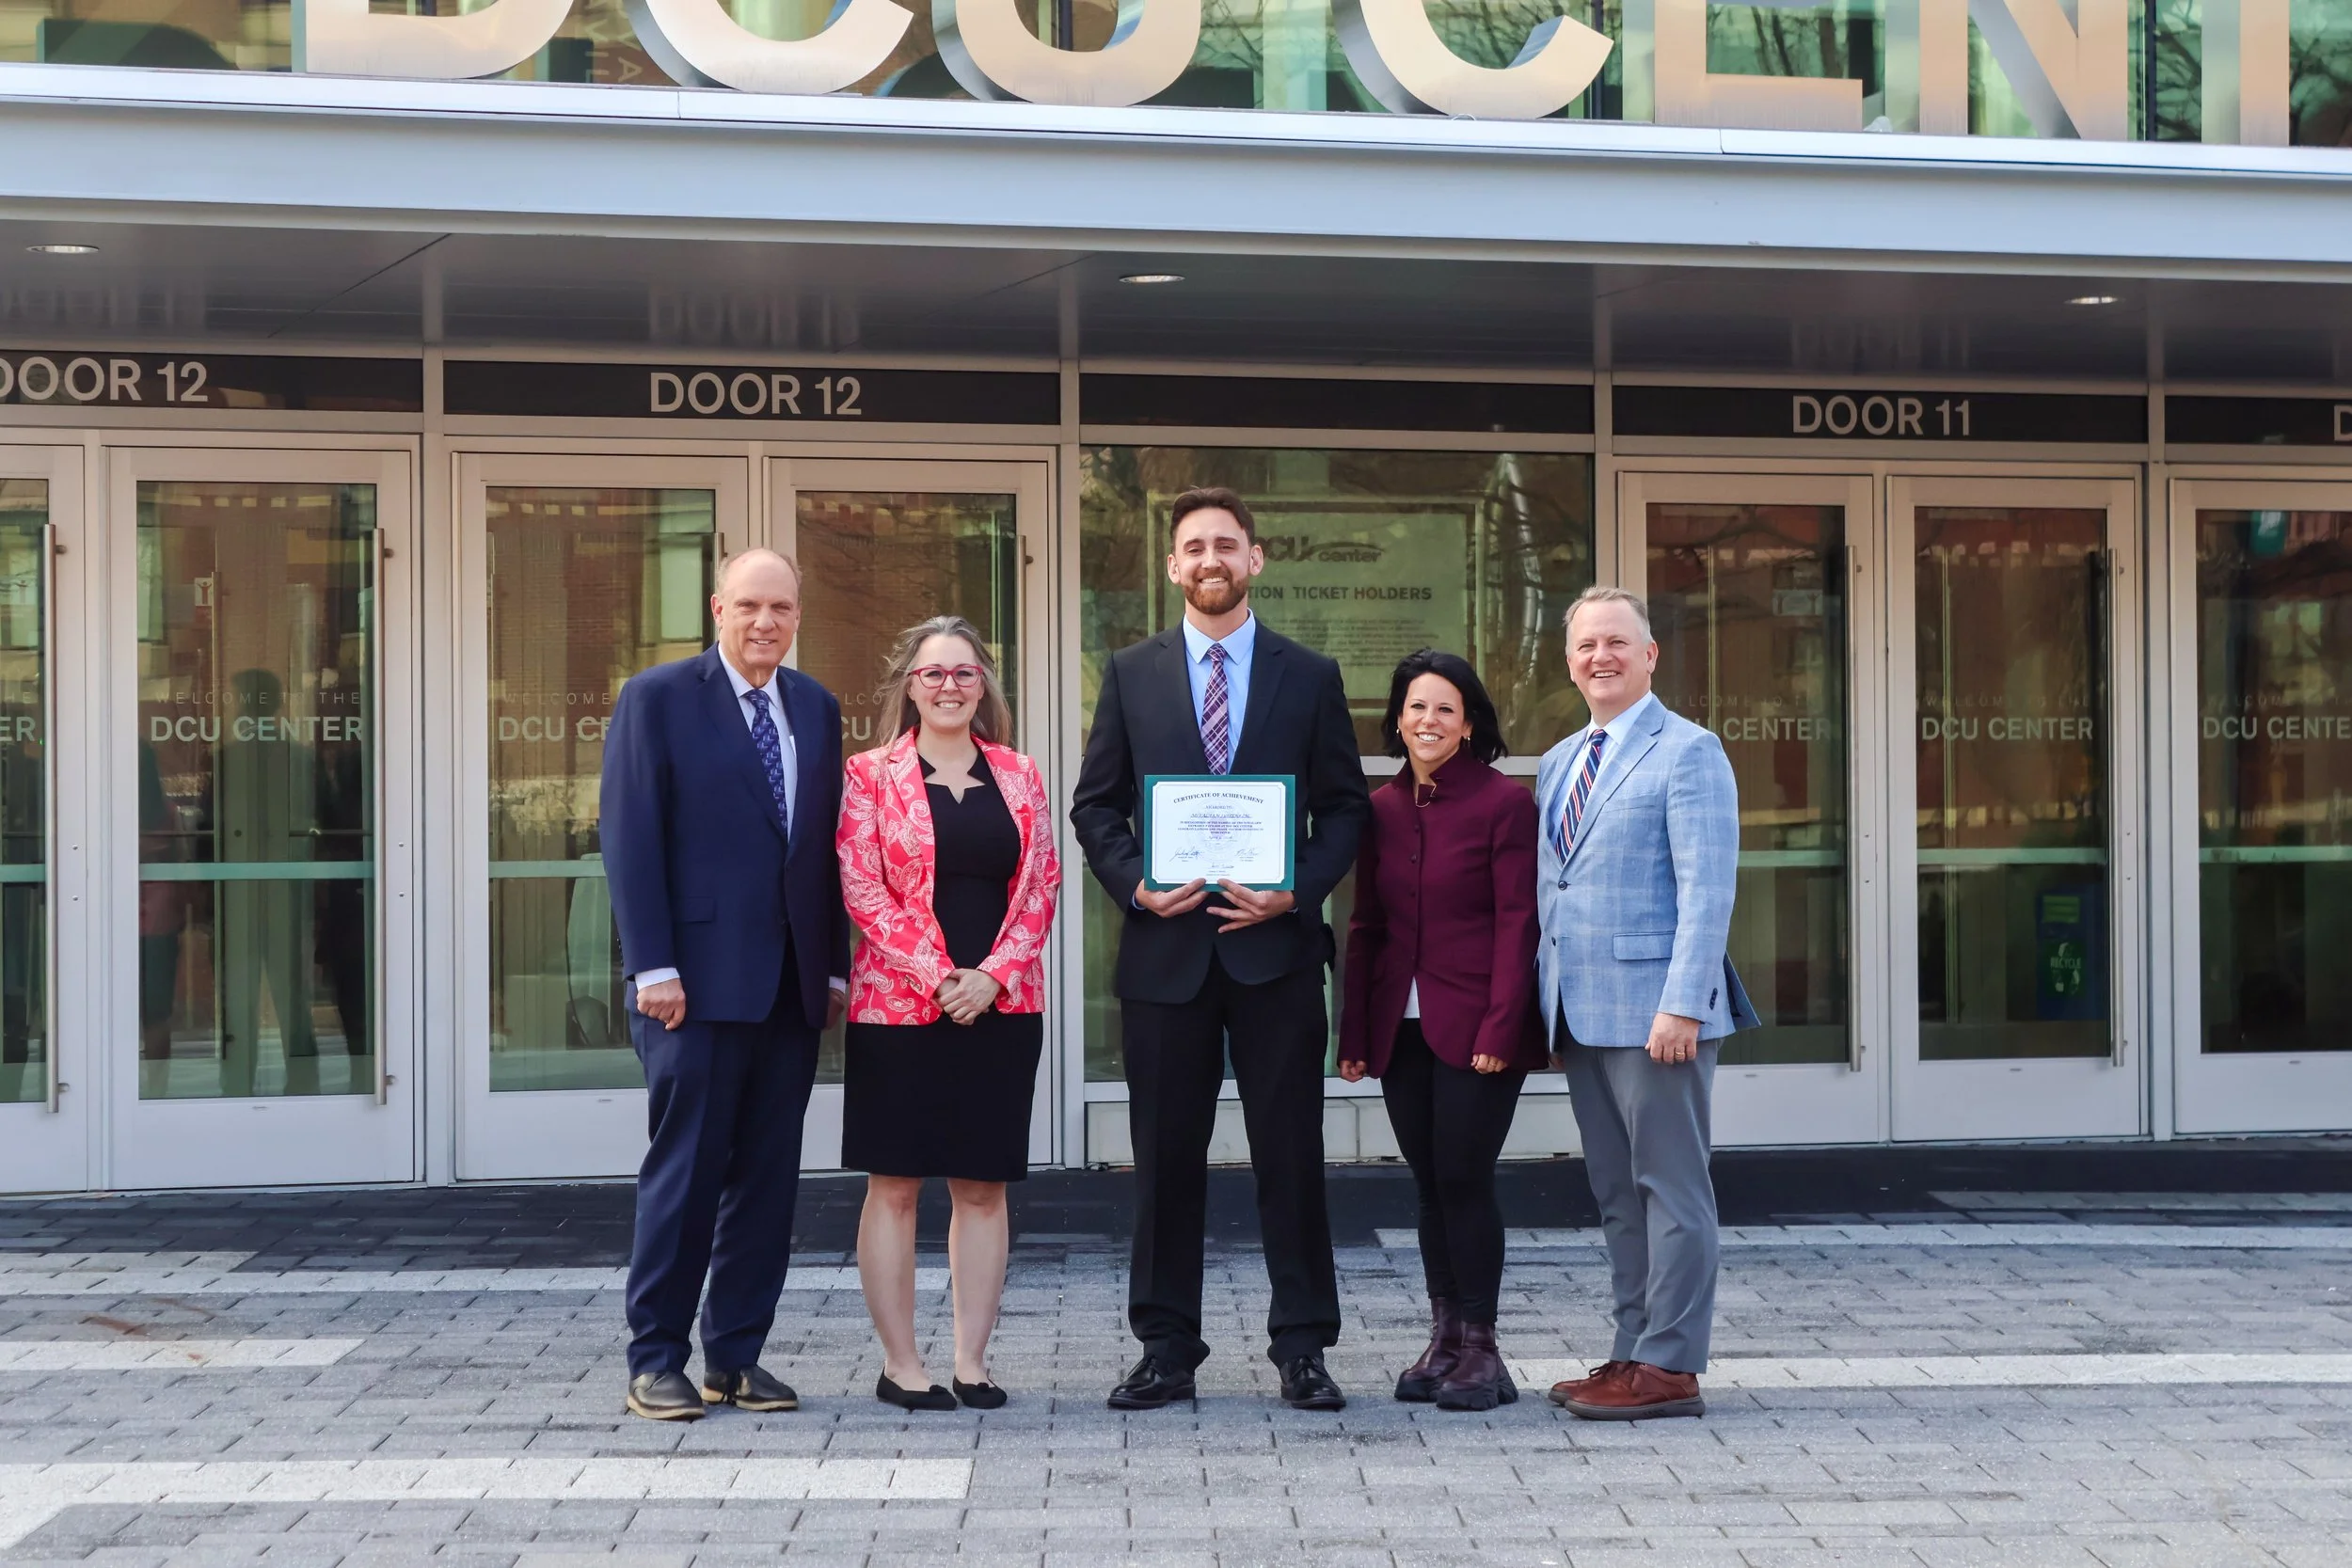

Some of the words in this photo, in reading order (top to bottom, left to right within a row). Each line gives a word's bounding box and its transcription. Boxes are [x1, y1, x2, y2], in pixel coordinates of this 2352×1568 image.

[156, 361, 208, 402] 12
[650, 372, 802, 415] DOOR
[814, 376, 862, 415] 12
[1792, 395, 1924, 436] DOOR
[1935, 399, 1970, 436] 11
[1318, 548, 1382, 562] center
[1293, 586, 1349, 600] TICKET
[1354, 587, 1432, 600] HOLDERS
[156, 692, 268, 705] WELCOME
[320, 692, 360, 705] THE
[505, 692, 611, 705] WELCOME
[151, 716, 220, 741] DCU
[232, 716, 361, 741] CENTER
[499, 716, 564, 741] DCU
[1723, 717, 1832, 741] CENTER
[1922, 717, 1978, 741] DCU
[1988, 717, 2092, 741] CENTER
[2202, 717, 2257, 740] DCU
[2266, 717, 2352, 740] CENTE
[1173, 793, 1211, 803] CERTIFICATE
[1222, 792, 1263, 804] ACHIEVEMENT
